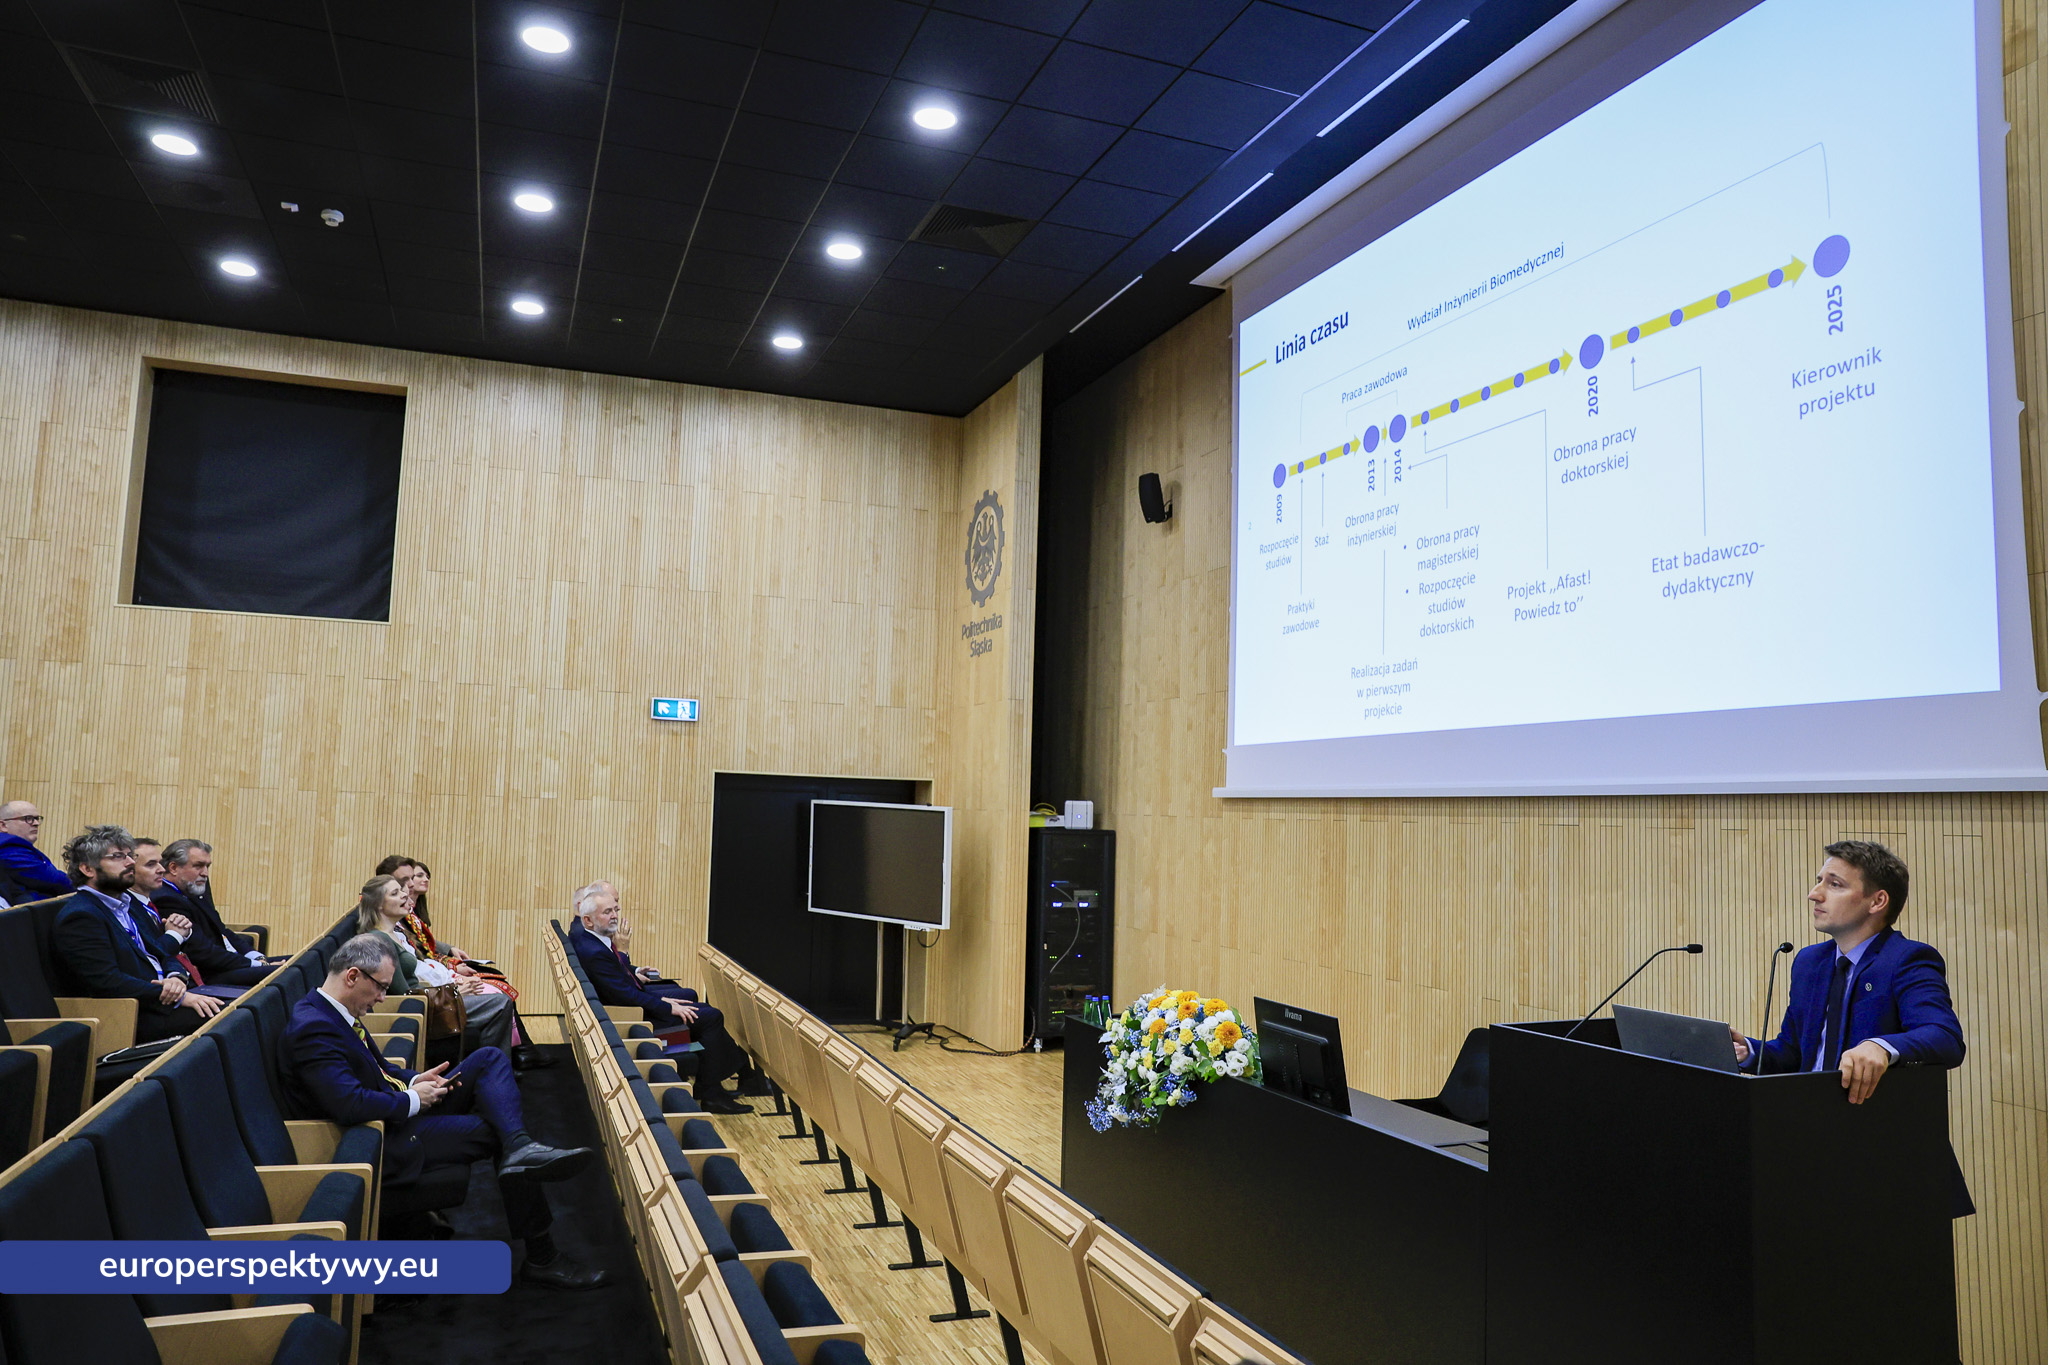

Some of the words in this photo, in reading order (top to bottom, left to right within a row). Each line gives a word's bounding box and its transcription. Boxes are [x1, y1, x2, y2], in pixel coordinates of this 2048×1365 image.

[1407, 304, 1442, 331] Wydział
[1444, 281, 1487, 313] Inżynierii
[1490, 241, 1565, 290] Biomedycznej
[1827, 284, 1844, 336] 2025
[1275, 333, 1306, 364] Linia
[1310, 311, 1350, 346] czasu
[1792, 346, 1882, 389] Kierownik
[1341, 386, 1363, 404] Praca
[1364, 365, 1408, 394] zawodowa
[1588, 375, 1599, 418] 2020
[1799, 382, 1875, 420] projektu
[1553, 438, 1598, 462] Obrona
[1602, 426, 1637, 452] pracy
[1367, 458, 1375, 492] 2013
[1394, 448, 1402, 483] 2014
[1561, 452, 1630, 484] doktorskiej
[1345, 511, 1375, 528] Obrona
[1377, 503, 1400, 520] pracy
[1260, 532, 1299, 555] Rozpoczęcie
[1314, 532, 1330, 548] Staż
[1347, 523, 1397, 547] inżynierskiej
[1416, 532, 1451, 550] Obrona
[1453, 524, 1480, 541] pracy
[1265, 554, 1292, 571] studiów
[1417, 544, 1479, 571] magisterskiej
[1652, 554, 1679, 574] Etat
[1683, 540, 1765, 567] badawczo-
[1418, 572, 1476, 595] Rozpoczęcie
[1507, 580, 1546, 600] Projekt
[1662, 569, 1754, 599] dydaktyczny
[1287, 598, 1315, 615] Praktyki
[1428, 597, 1466, 614] studiów
[1514, 601, 1561, 622] Powiedz
[962, 613, 1002, 640] Politechnika
[1282, 617, 1320, 635] zawodowe
[1419, 616, 1475, 637] doktorskich
[970, 637, 993, 658] Śląska
[1350, 661, 1390, 679] Realizacja
[1392, 657, 1418, 674] zadań
[1357, 688, 1364, 698] w
[1366, 681, 1411, 699] pierwszym
[1364, 703, 1403, 720] projekcie
